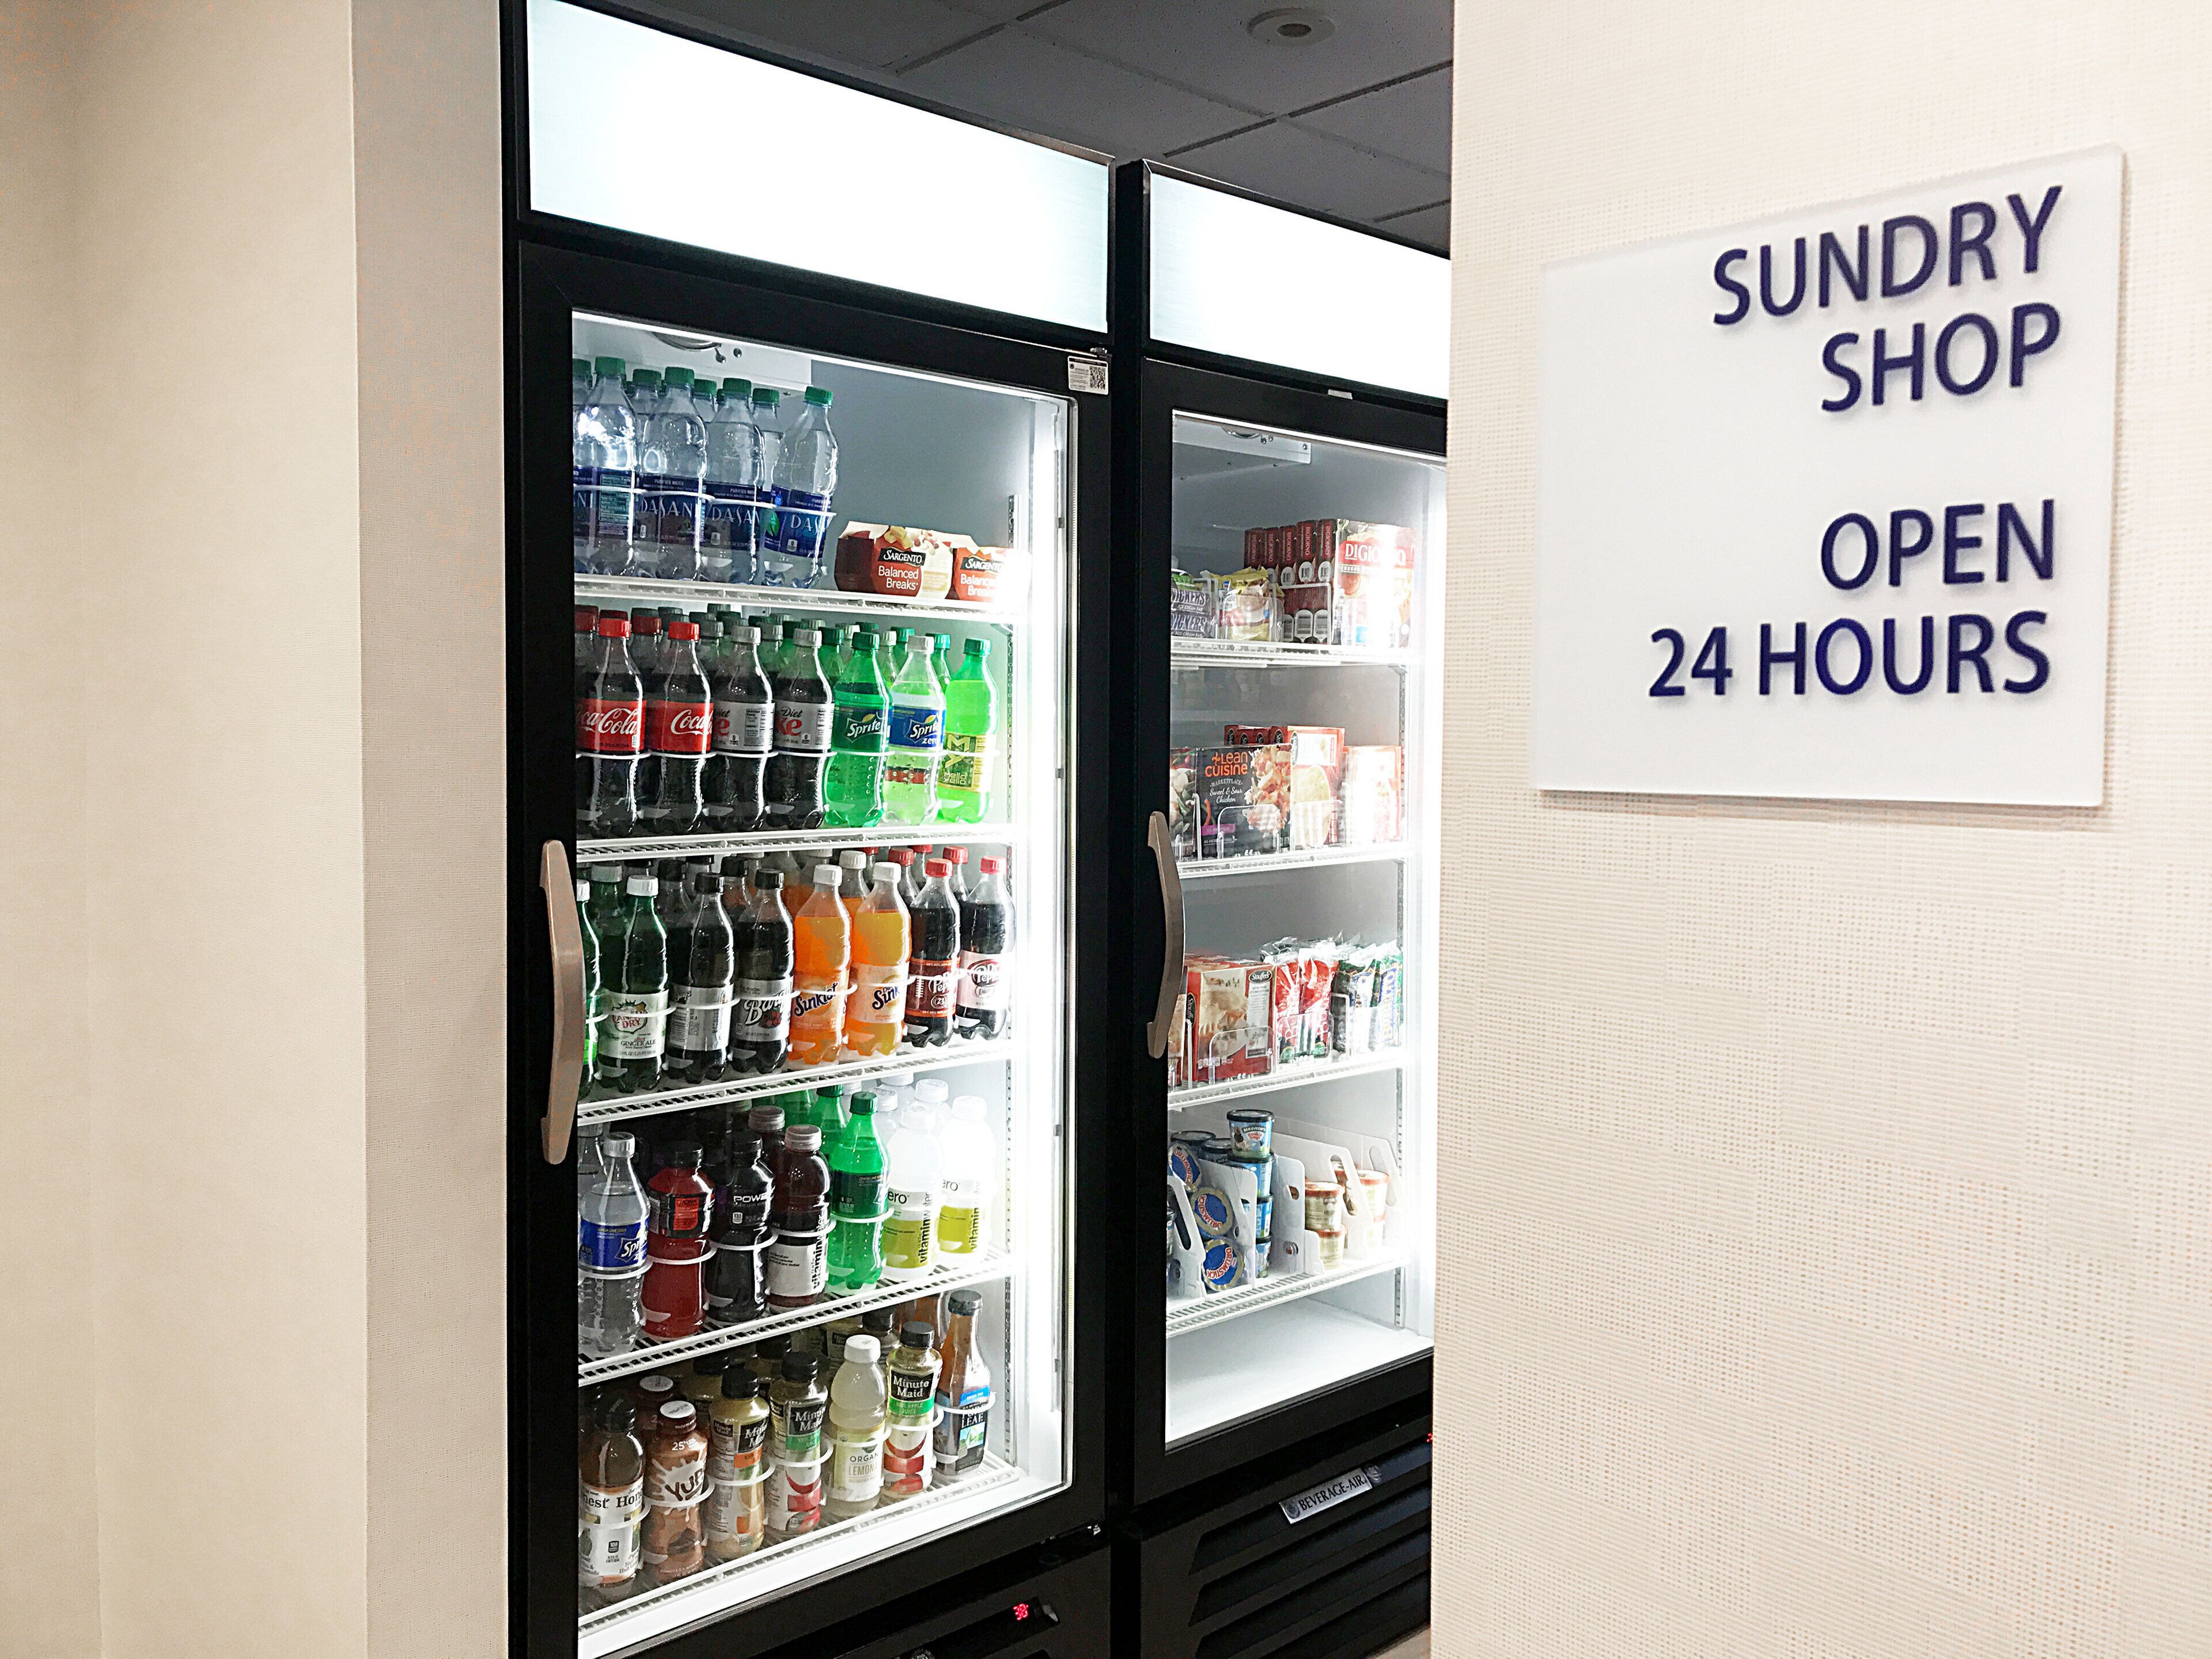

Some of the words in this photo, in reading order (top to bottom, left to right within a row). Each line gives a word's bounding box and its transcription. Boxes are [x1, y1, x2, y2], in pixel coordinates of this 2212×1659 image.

[1713, 185, 2063, 325] SUNDRY
[1821, 302, 2061, 412] SHOP
[1820, 499, 2055, 590] OPEN
[884, 550, 923, 565] SARGENTO
[1344, 543, 1406, 566] DIGIOO
[878, 566, 919, 579] Balanced
[887, 578, 916, 590] Breaks
[1171, 588, 1206, 605] NICKERS
[1649, 626, 1733, 696] 24
[1759, 611, 2050, 696] HOURS
[781, 706, 803, 718] Diet
[847, 719, 881, 738] Sprite
[1221, 751, 1248, 764] Lean
[1210, 788, 1225, 797] Sweet
[1216, 794, 1236, 804] Chicken
[622, 1018, 641, 1028] DRY
[888, 1190, 907, 1205] ero
[1207, 1247, 1233, 1279] DRUMSTICK
[893, 1375, 930, 1389] Minute
[897, 1386, 925, 1398] Maid
[1298, 1474, 1366, 1510] BEVERAGE-AIR
